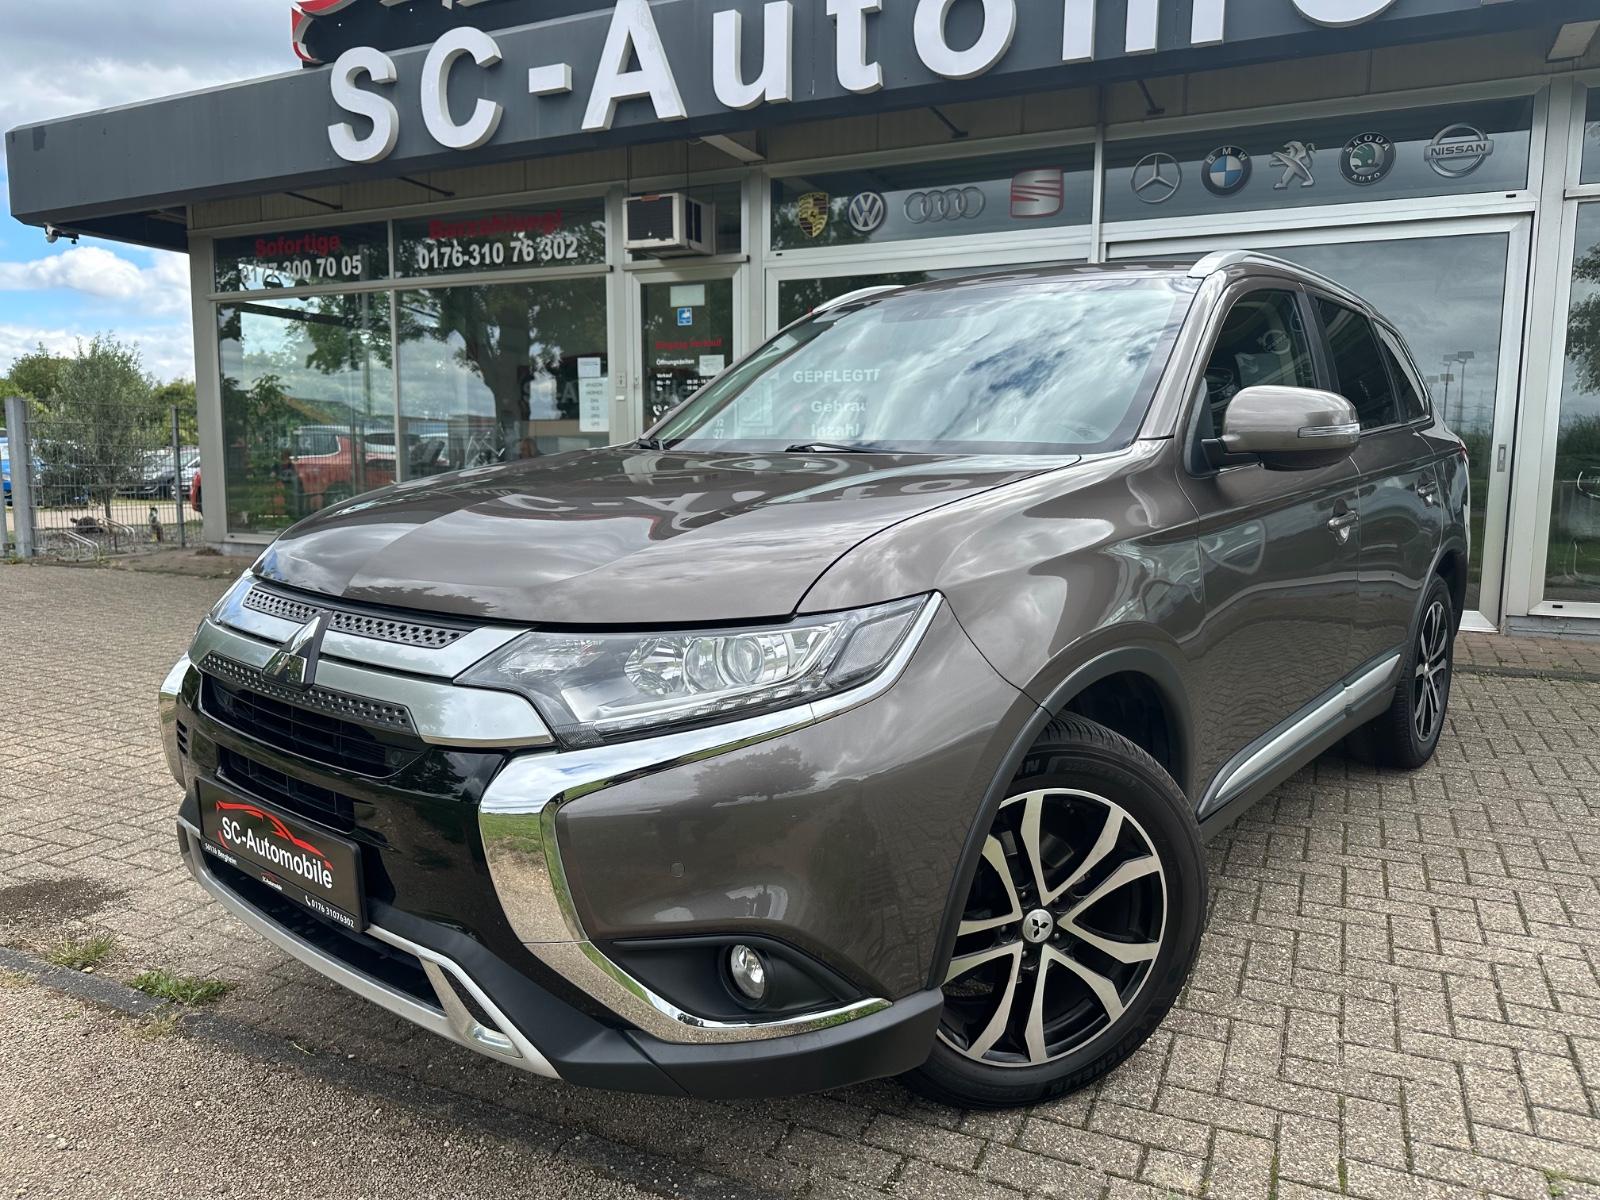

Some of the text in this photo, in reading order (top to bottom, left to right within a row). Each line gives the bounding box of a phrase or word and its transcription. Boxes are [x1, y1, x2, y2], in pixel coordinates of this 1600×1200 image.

[1206, 147, 1249, 164] BMW
[1430, 143, 1487, 156] NISSAN
[1351, 171, 1381, 182] AUTO
[256, 234, 342, 258] Sofortige
[418, 236, 579, 270] 0176-310 76 302
[316, 257, 337, 278] 70
[341, 255, 362, 276] 05
[222, 816, 333, 889] SC-Automobile
[311, 900, 355, 928] 0176 31076302
